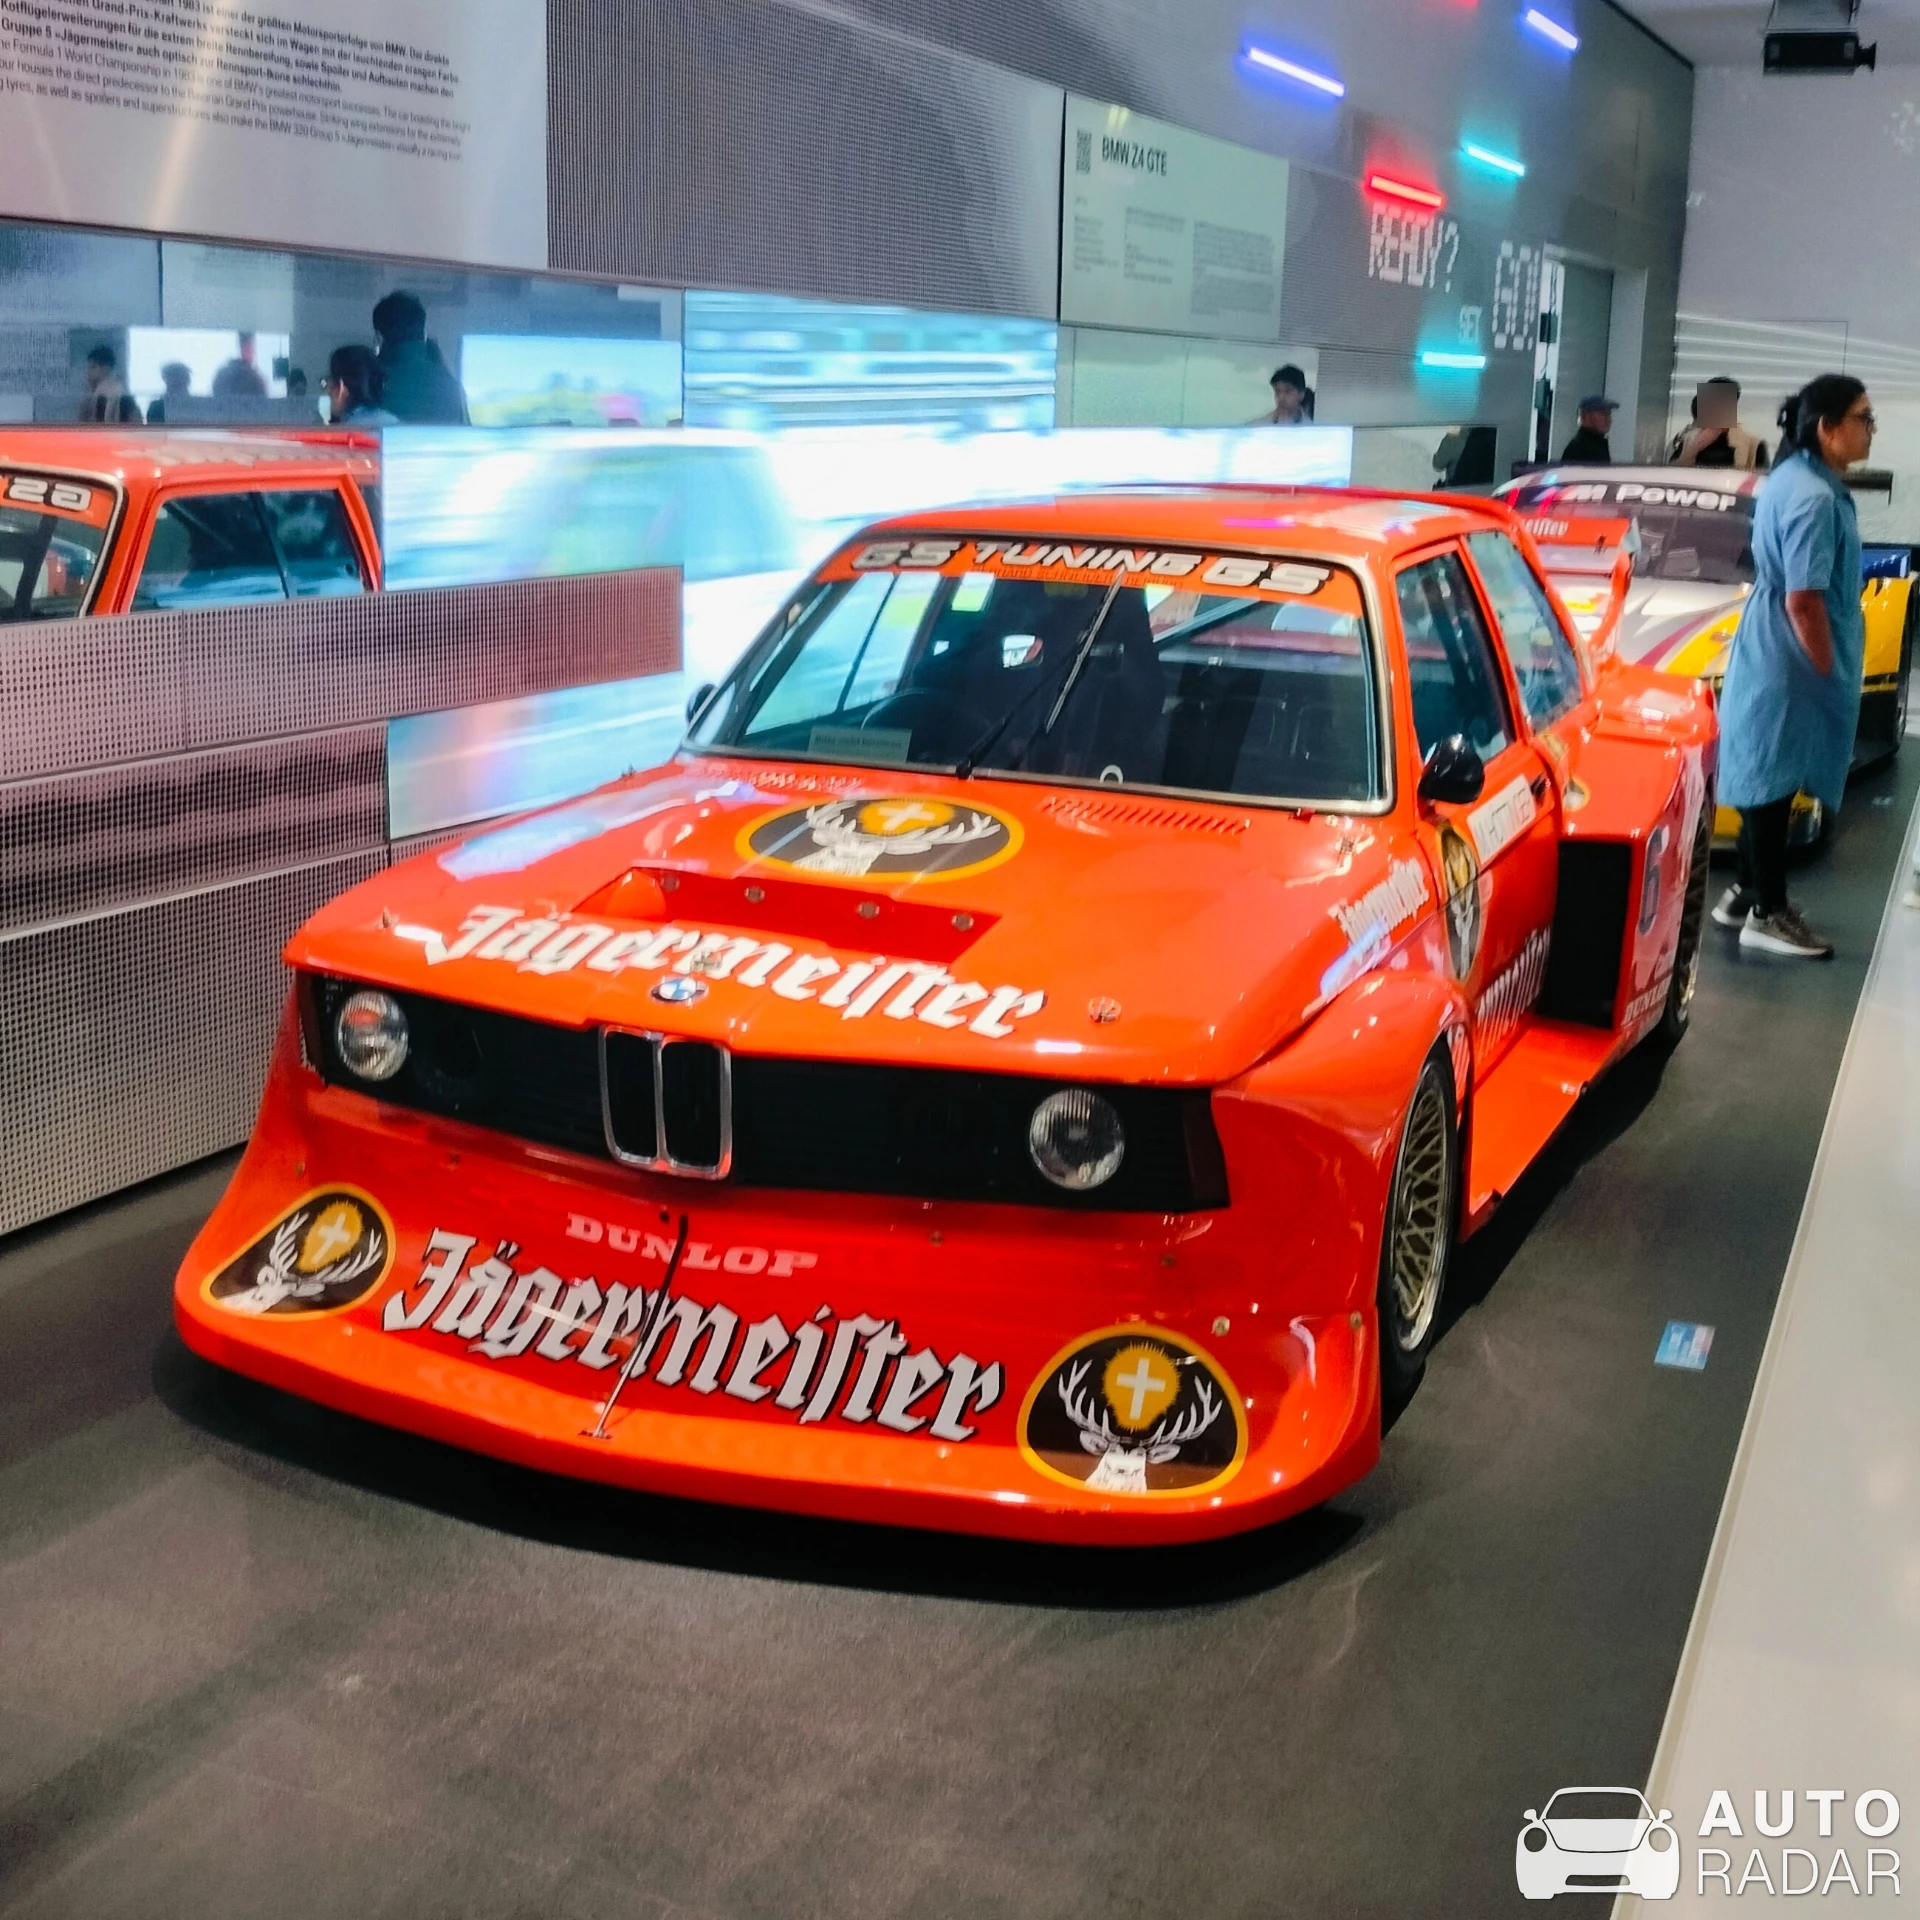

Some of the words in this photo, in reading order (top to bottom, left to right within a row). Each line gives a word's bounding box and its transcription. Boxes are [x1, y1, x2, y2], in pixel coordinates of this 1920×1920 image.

[2, 17, 42, 38] Gruppe
[45, 25, 52, 38] 5
[137, 45, 160, 58] auch
[162, 49, 198, 64] optisch
[200, 58, 214, 68] zur
[217, 57, 290, 82] Rennsport-Ikone
[128, 22, 141, 36] für
[144, 26, 159, 39] die
[162, 31, 194, 47] extrem
[197, 36, 223, 52] breite
[295, 58, 319, 71] sowie
[321, 60, 349, 76] Spoiler
[352, 69, 366, 80] und
[369, 71, 408, 88] Aufbauten
[410, 81, 439, 93] machen
[440, 86, 454, 98] den
[179, 0, 200, 11] 1983
[202, 5, 214, 14] ist
[241, 10, 255, 20] der
[257, 16, 291, 31] größten
[294, 22, 368, 49] Motorsporterfolge
[369, 42, 383, 51] von
[410, 46, 422, 60] Der
[424, 50, 449, 66] direkte
[211, 23, 253, 40] versteckt
[256, 31, 274, 45] sich
[277, 36, 288, 48] im
[290, 37, 319, 55] Wagen
[322, 47, 335, 58] mit
[338, 48, 351, 61] der
[353, 51, 403, 72] leuchtenden
[405, 64, 436, 79] orangen
[1102, 134, 1131, 168] BMW
[1132, 145, 1144, 169] Z4
[1146, 147, 1168, 176] GTE
[1615, 484, 1737, 512] Power
[851, 540, 963, 569] GS
[972, 540, 1203, 578] TUNING
[1201, 553, 1336, 596] GS
[565, 1211, 818, 1277] DUNLOP
